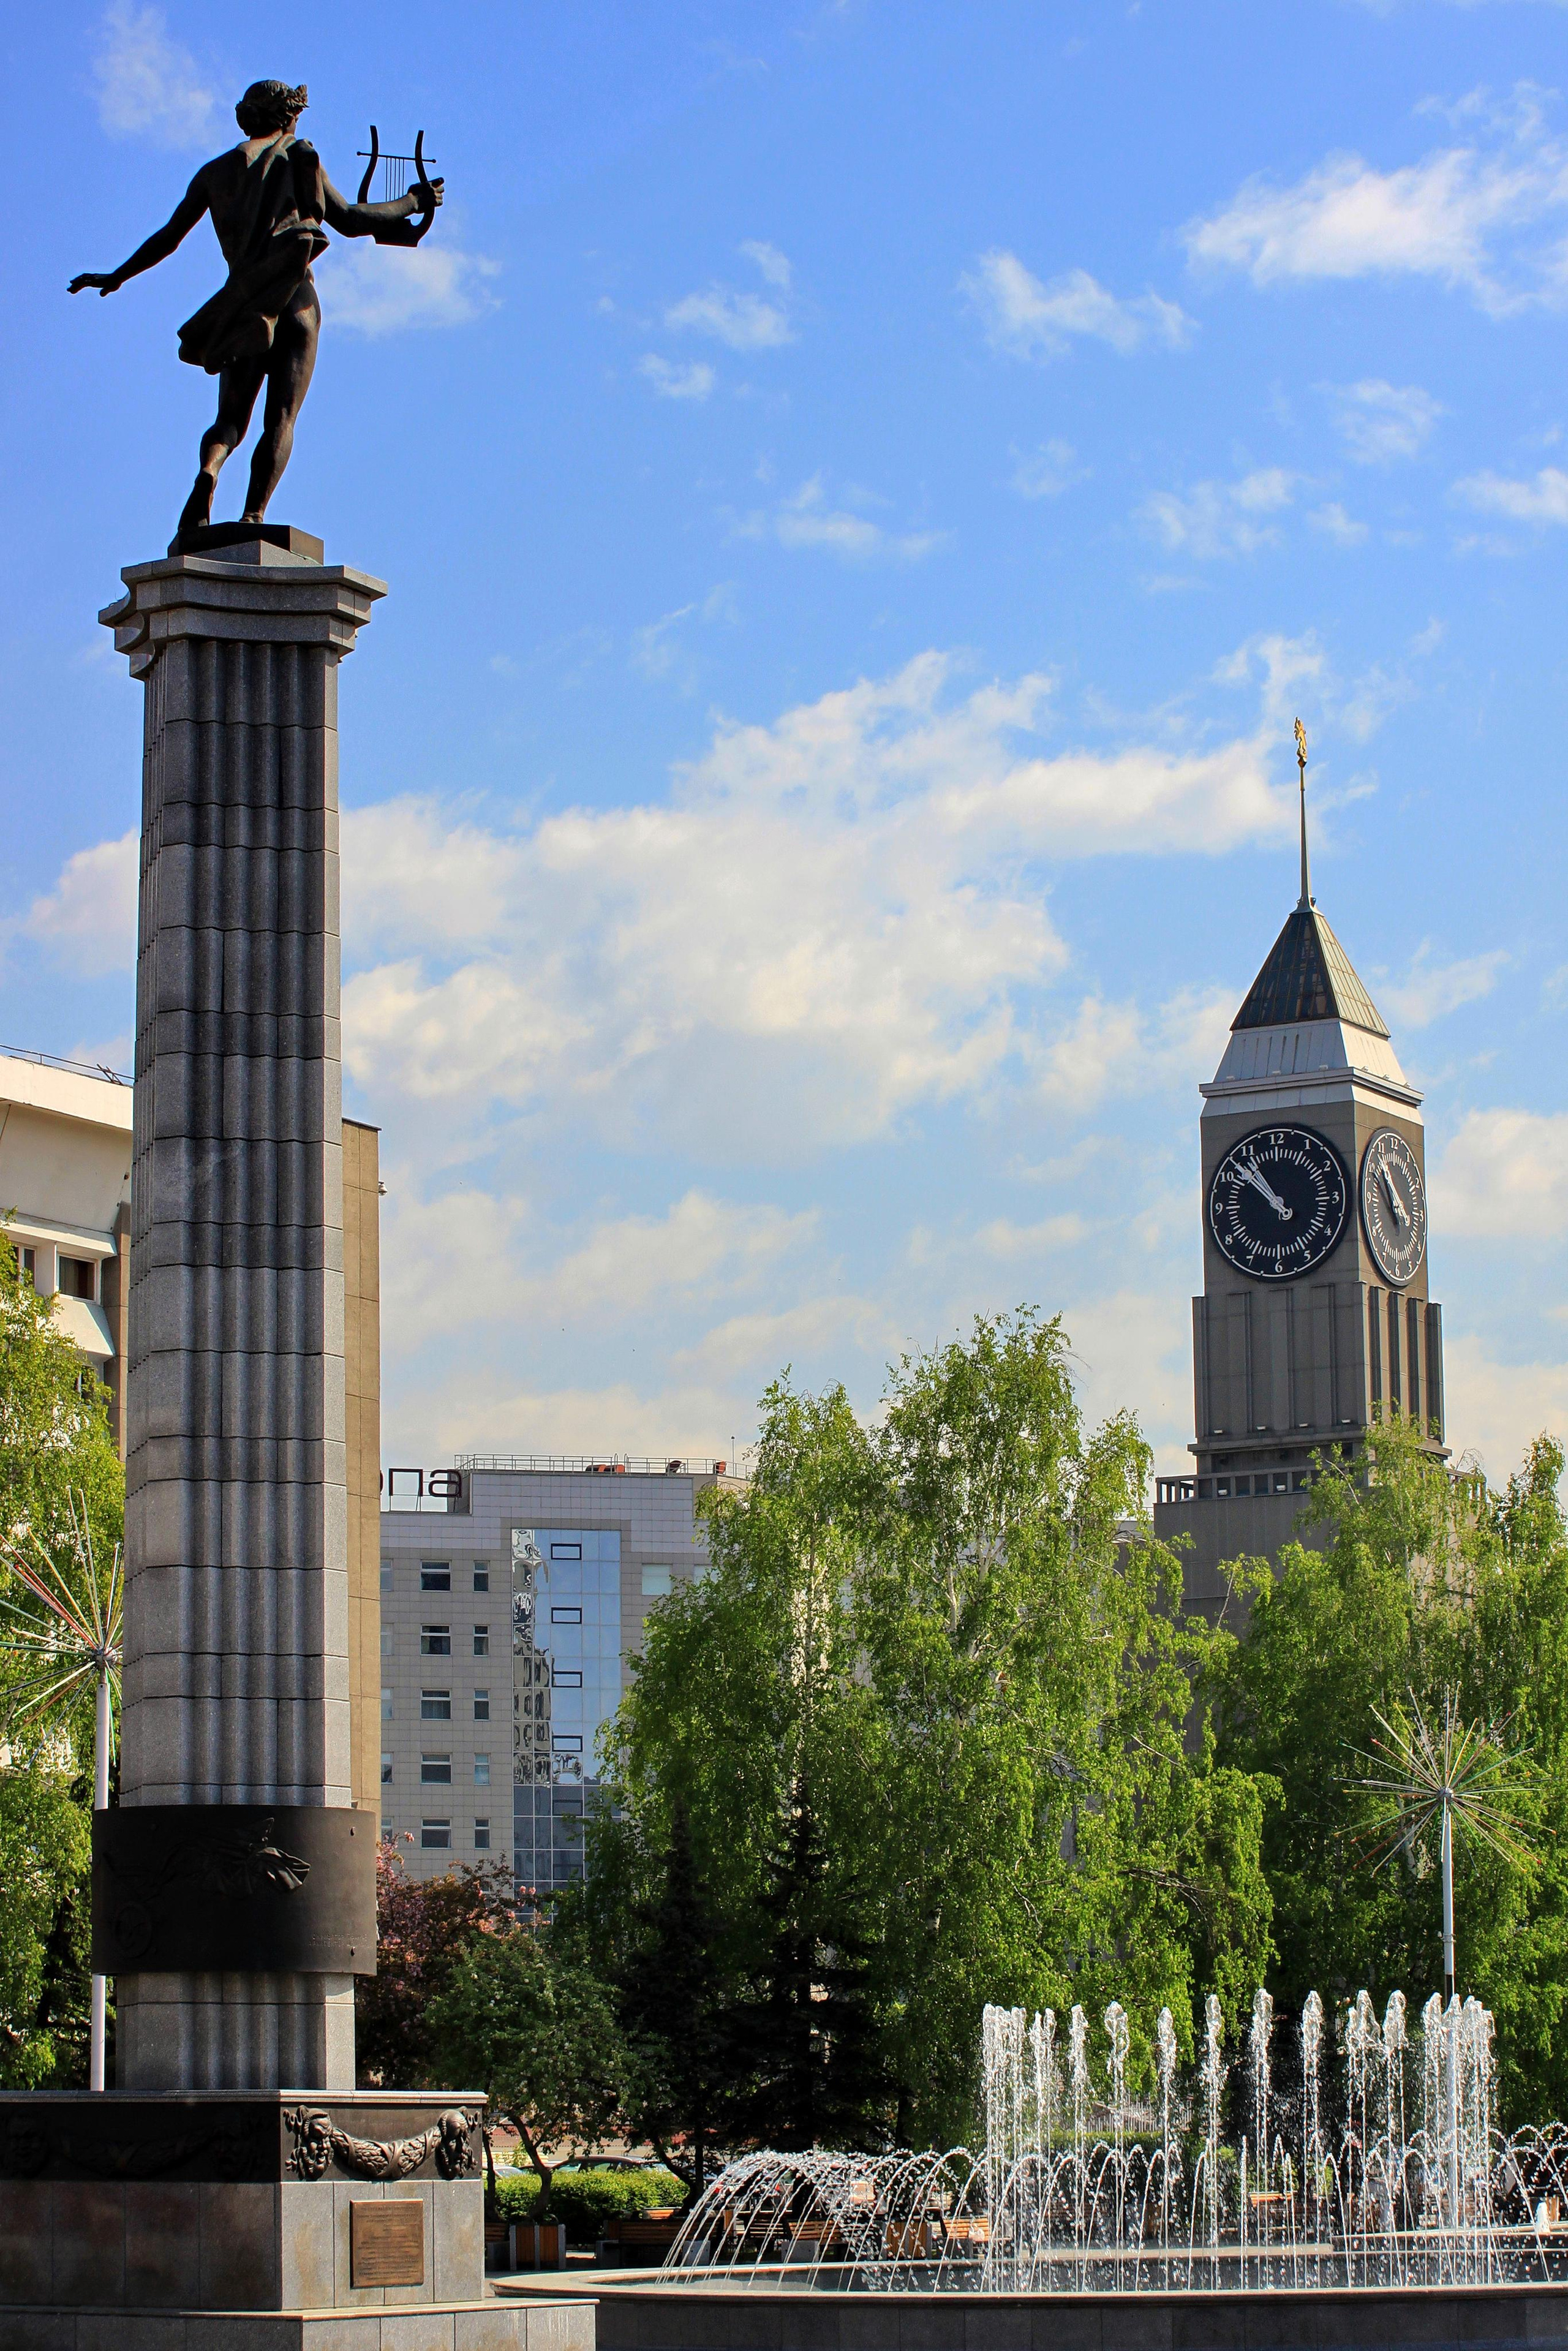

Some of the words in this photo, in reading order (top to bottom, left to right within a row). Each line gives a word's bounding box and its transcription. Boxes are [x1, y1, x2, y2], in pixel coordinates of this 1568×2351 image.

[1269, 1133, 1284, 1145] 12
[1304, 1139, 1311, 1150] 1
[1390, 1138, 1398, 1150] 12
[1241, 1144, 1255, 1157] 11
[1377, 1141, 1385, 1153] 11
[1406, 1152, 1410, 1163] 1
[1323, 1160, 1331, 1171] 2
[1219, 1171, 1234, 1182] 10
[1415, 1177, 1419, 1188] 2
[1332, 1191, 1340, 1204] 3
[1366, 1191, 1371, 1204] 9
[1215, 1202, 1223, 1215] 9
[1419, 1210, 1423, 1221] 3
[1324, 1224, 1332, 1236] 4
[1372, 1226, 1377, 1236] 8
[1225, 1234, 1233, 1245] 8
[1246, 1255, 1254, 1266] 7
[1303, 1250, 1311, 1262] 5
[1275, 1259, 1283, 1273] 6
[1395, 1264, 1400, 1277] 6
[1408, 1261, 1412, 1272] 5
[380, 1468, 462, 1498] па
